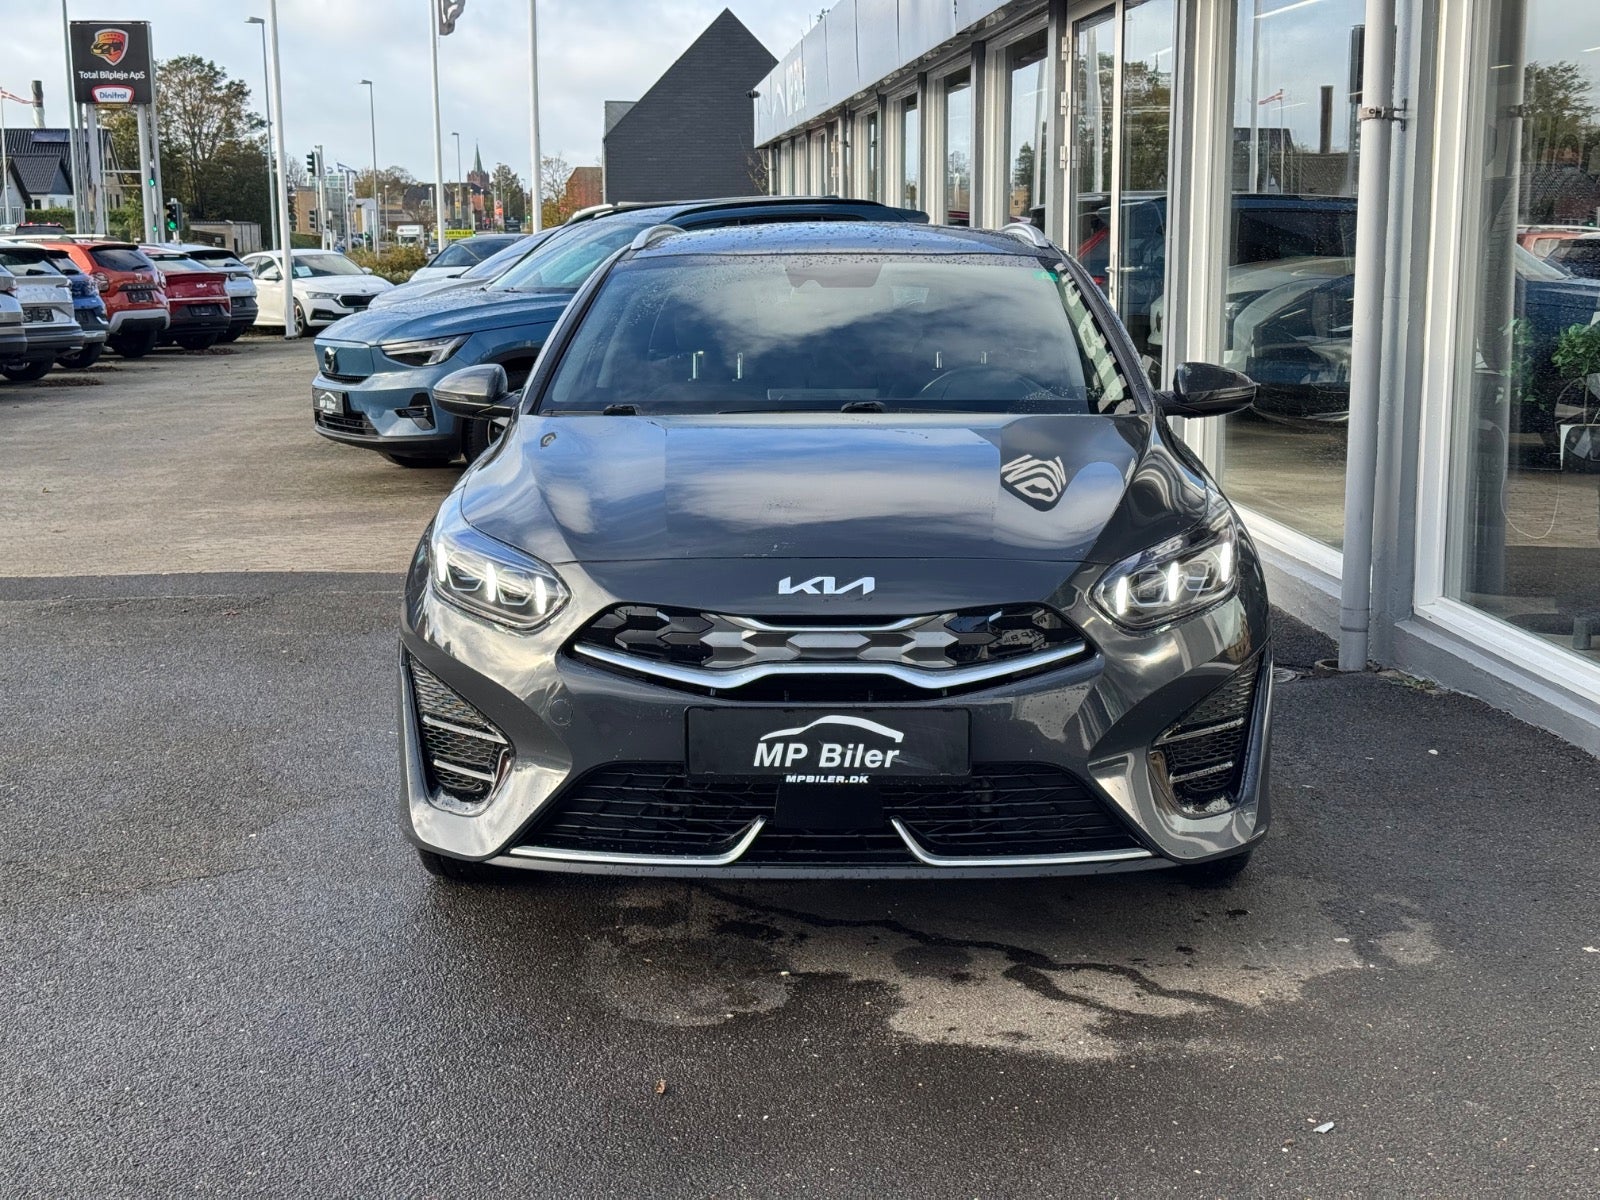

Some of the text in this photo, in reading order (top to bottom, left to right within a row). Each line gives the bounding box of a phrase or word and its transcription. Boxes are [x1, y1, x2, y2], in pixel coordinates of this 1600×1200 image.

[78, 70, 146, 80] Total Bilpleje ApS
[99, 91, 127, 99] Dinitrol
[778, 576, 875, 595] KIA
[753, 743, 900, 768] MP Biler
[785, 775, 869, 783] MPBILER.DK
